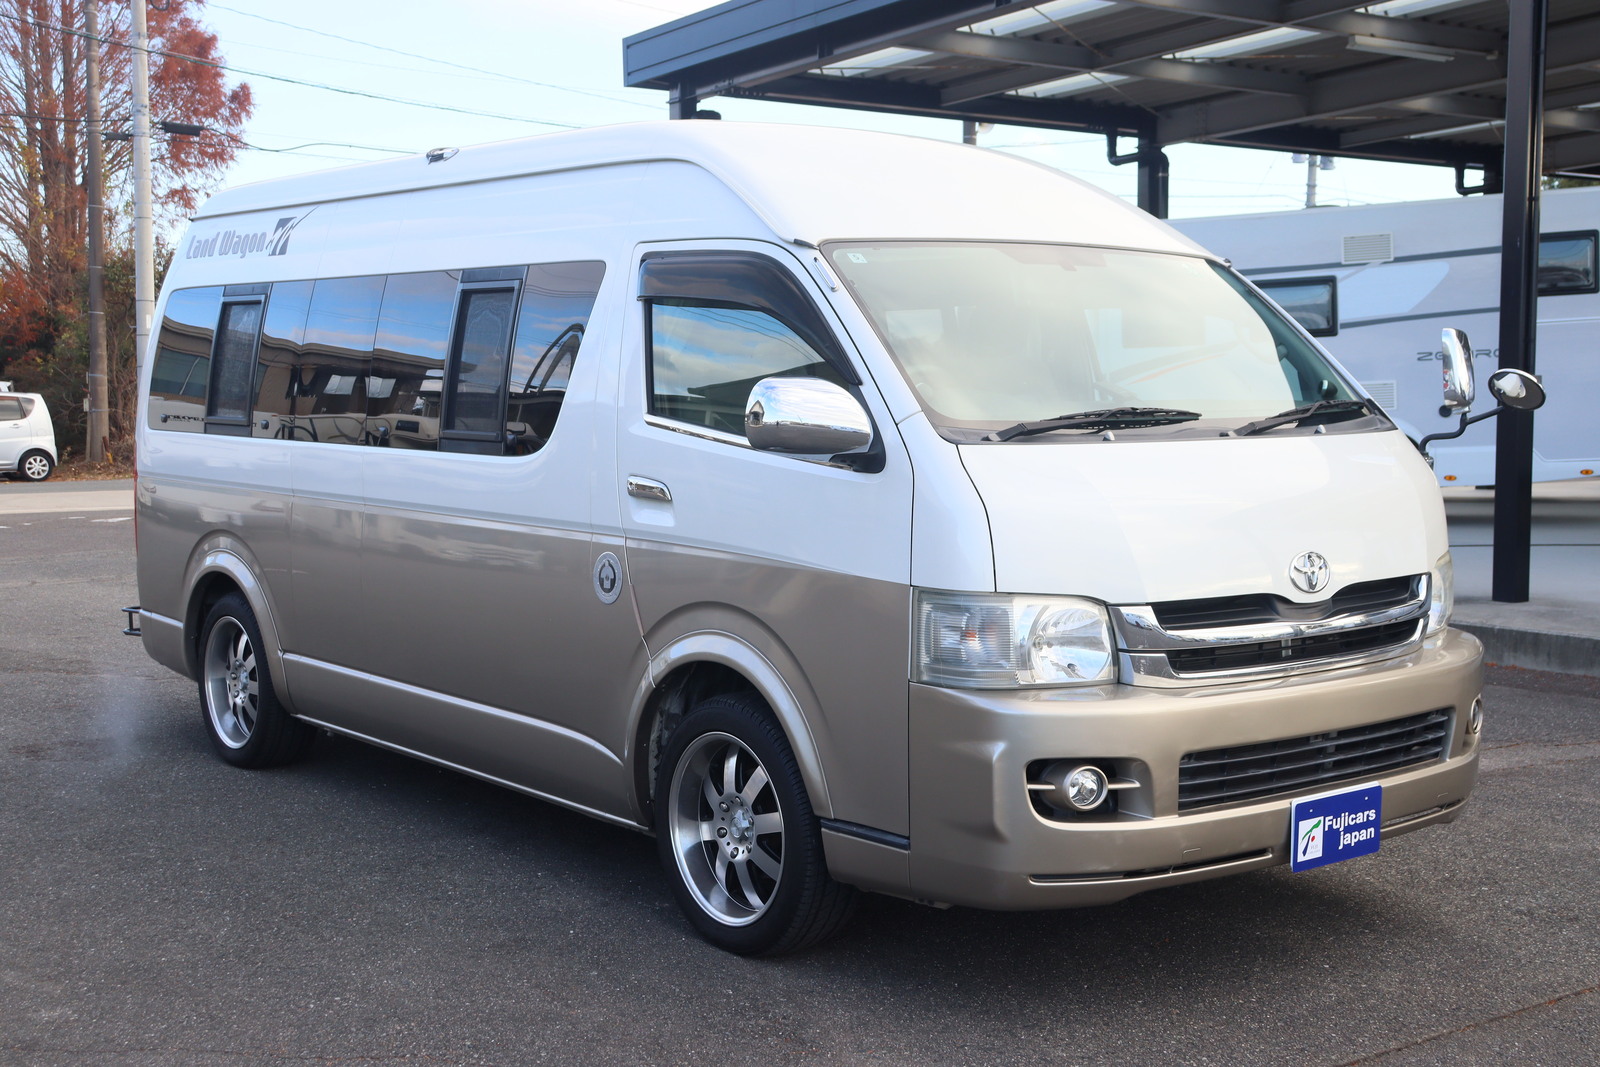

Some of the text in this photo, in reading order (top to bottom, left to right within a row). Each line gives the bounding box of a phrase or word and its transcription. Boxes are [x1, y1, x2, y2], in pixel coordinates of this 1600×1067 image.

[186, 230, 267, 259] Land Wagon
[1325, 809, 1376, 831] Fujicars
[1338, 827, 1375, 850] japan
